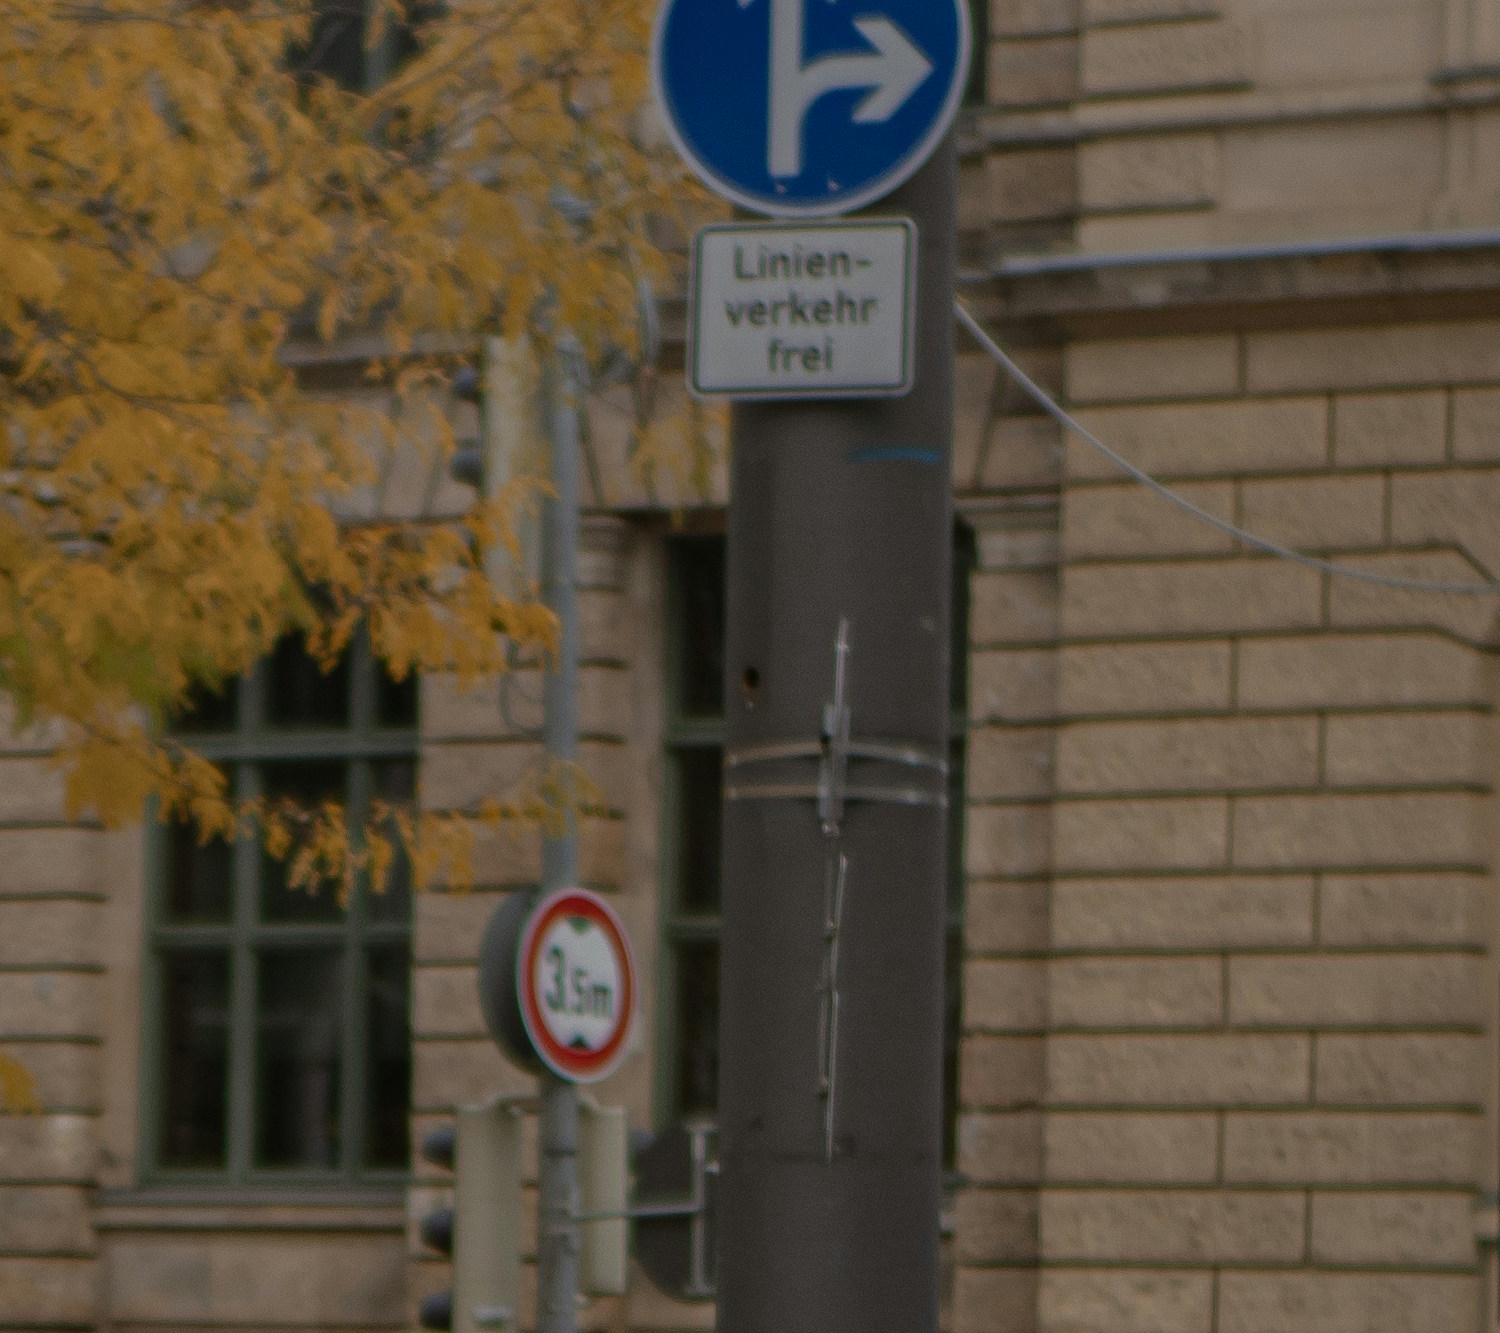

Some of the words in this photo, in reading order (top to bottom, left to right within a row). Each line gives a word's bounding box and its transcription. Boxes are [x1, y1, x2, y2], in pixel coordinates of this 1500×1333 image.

[733, 243, 872, 281] Linien-
[726, 290, 877, 327] verkehr
[767, 337, 834, 373] frei
